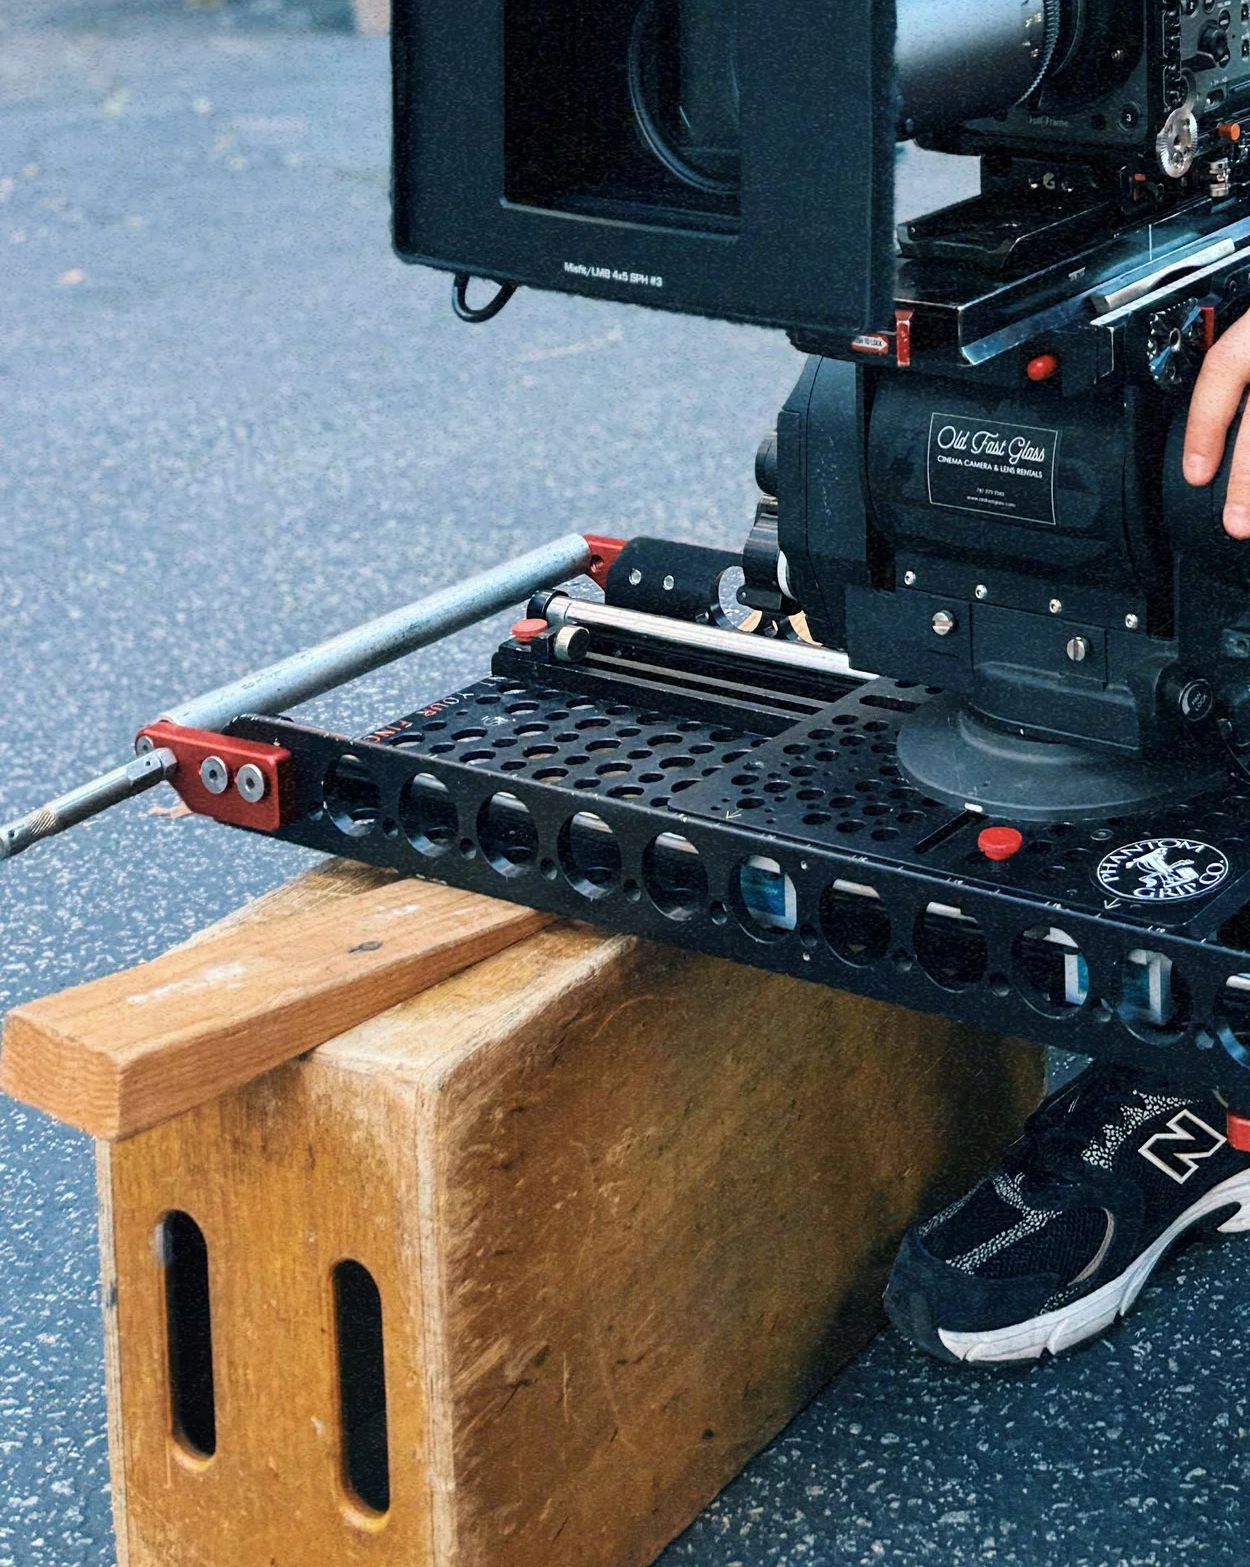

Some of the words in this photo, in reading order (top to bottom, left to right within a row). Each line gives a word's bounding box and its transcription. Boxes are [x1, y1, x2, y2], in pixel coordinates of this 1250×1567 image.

[1125, 113, 1133, 123] 3
[937, 425, 970, 450] Old
[970, 430, 1007, 454] Fast
[1008, 436, 1046, 465] Glass
[937, 454, 963, 466] CINEMA
[963, 459, 993, 471] CAMERA
[993, 463, 999, 472] &
[999, 465, 1015, 475] LENS
[1016, 468, 1044, 479] RENTALS
[1100, 839, 1206, 883] PHANTOM
[1198, 859, 1225, 885] CO.
[1133, 881, 1197, 899] GRIP
